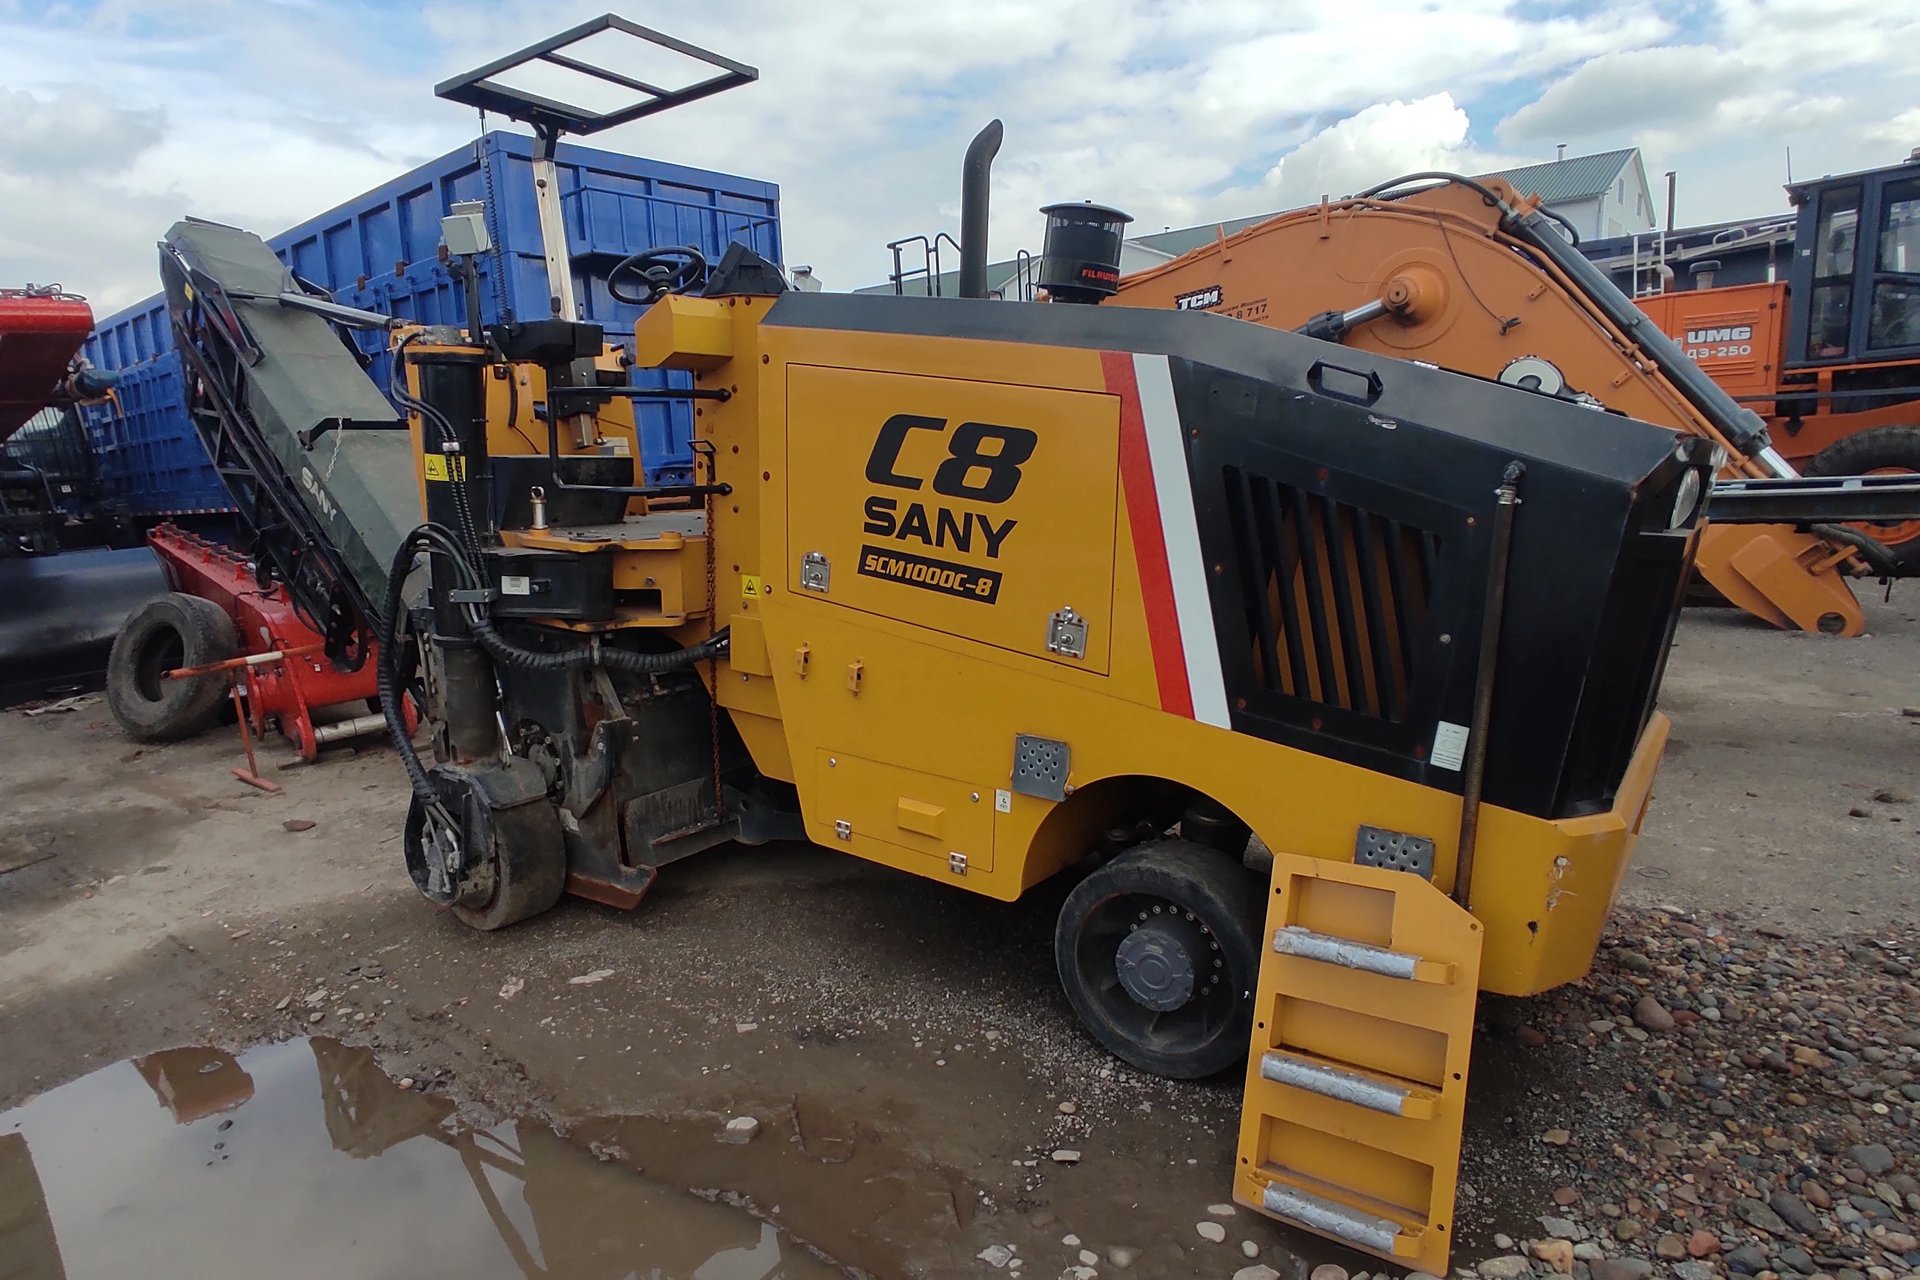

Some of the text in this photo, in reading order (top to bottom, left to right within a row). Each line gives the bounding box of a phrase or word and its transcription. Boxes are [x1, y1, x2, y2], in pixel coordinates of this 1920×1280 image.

[1178, 290, 1219, 311] TCM
[1687, 326, 1751, 344] UMG
[865, 413, 1038, 504] C8
[301, 466, 337, 522] SANY
[863, 496, 1018, 559] SANY
[864, 554, 993, 597] SCM1000C-8
